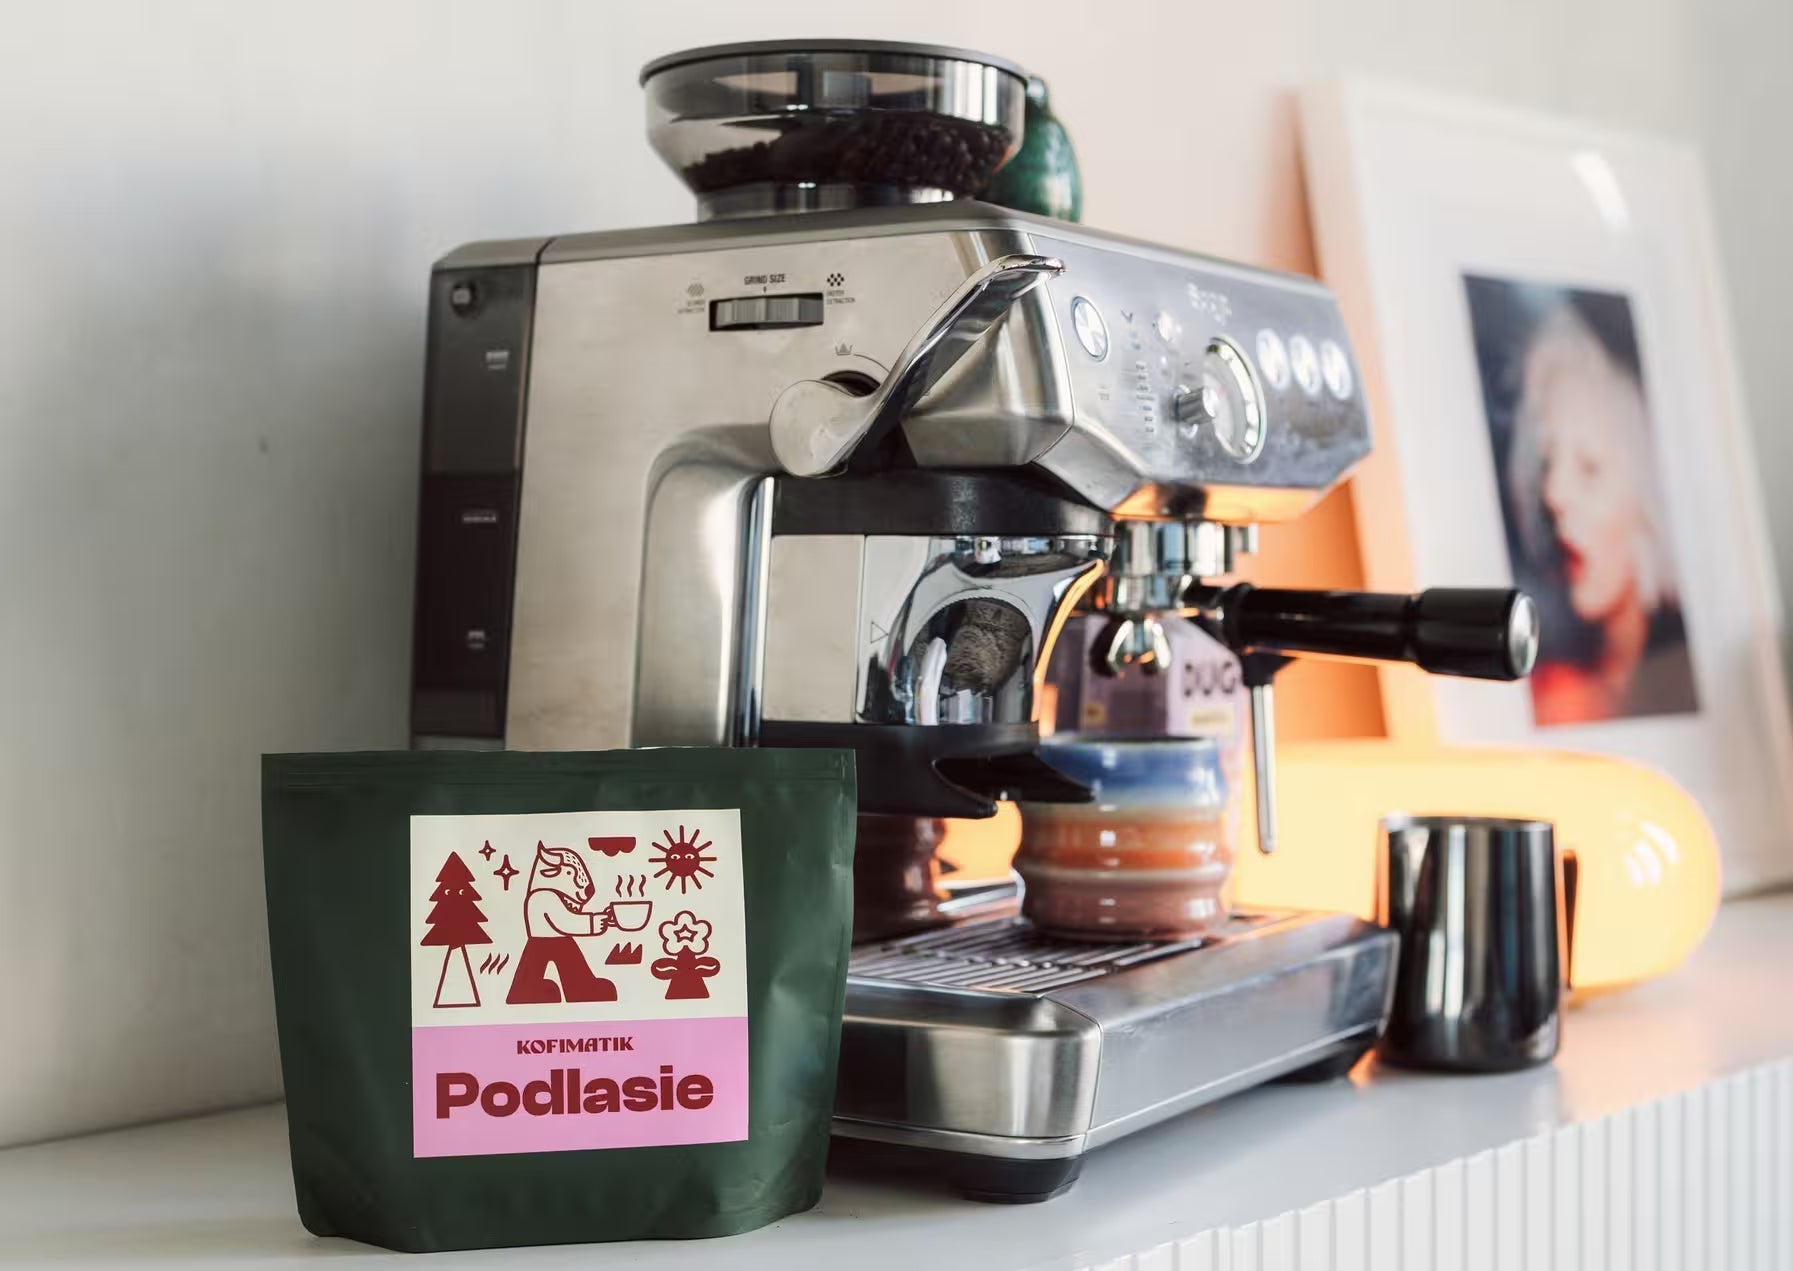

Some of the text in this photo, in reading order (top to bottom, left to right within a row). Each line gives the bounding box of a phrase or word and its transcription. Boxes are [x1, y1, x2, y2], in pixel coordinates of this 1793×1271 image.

[744, 273, 785, 285] GRIND SIZE
[516, 1036, 634, 1054] KOFIMATIK
[436, 1065, 714, 1119] Podlasie
